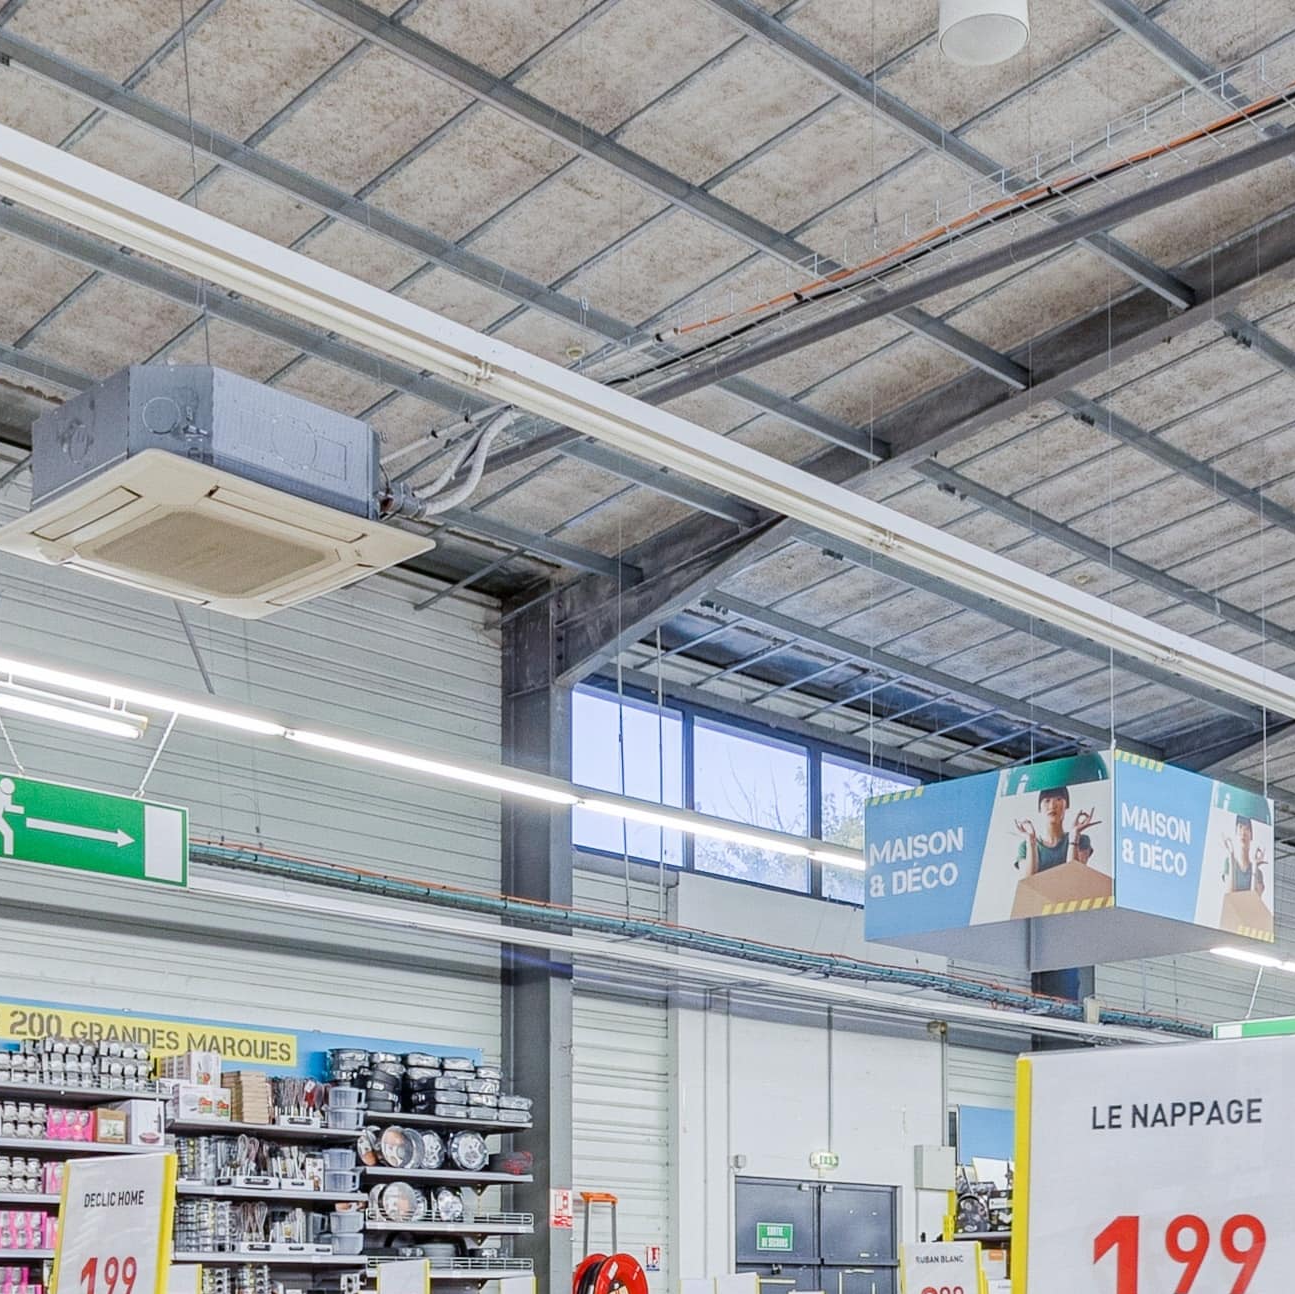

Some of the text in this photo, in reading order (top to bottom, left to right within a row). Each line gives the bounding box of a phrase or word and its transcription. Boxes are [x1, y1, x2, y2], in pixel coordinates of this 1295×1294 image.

[1121, 802, 1192, 845] MAISON
[869, 827, 964, 868] MAISON
[1121, 840, 1188, 877] & DÉCO
[870, 862, 958, 898] & DÉCO
[10, 1010, 62, 1038] 200
[71, 1020, 179, 1051] GRANDES
[187, 1033, 291, 1062] MARQUES
[1091, 1099, 1263, 1130] LE NAPPAGE
[84, 1190, 145, 1208] DECLIC HOME
